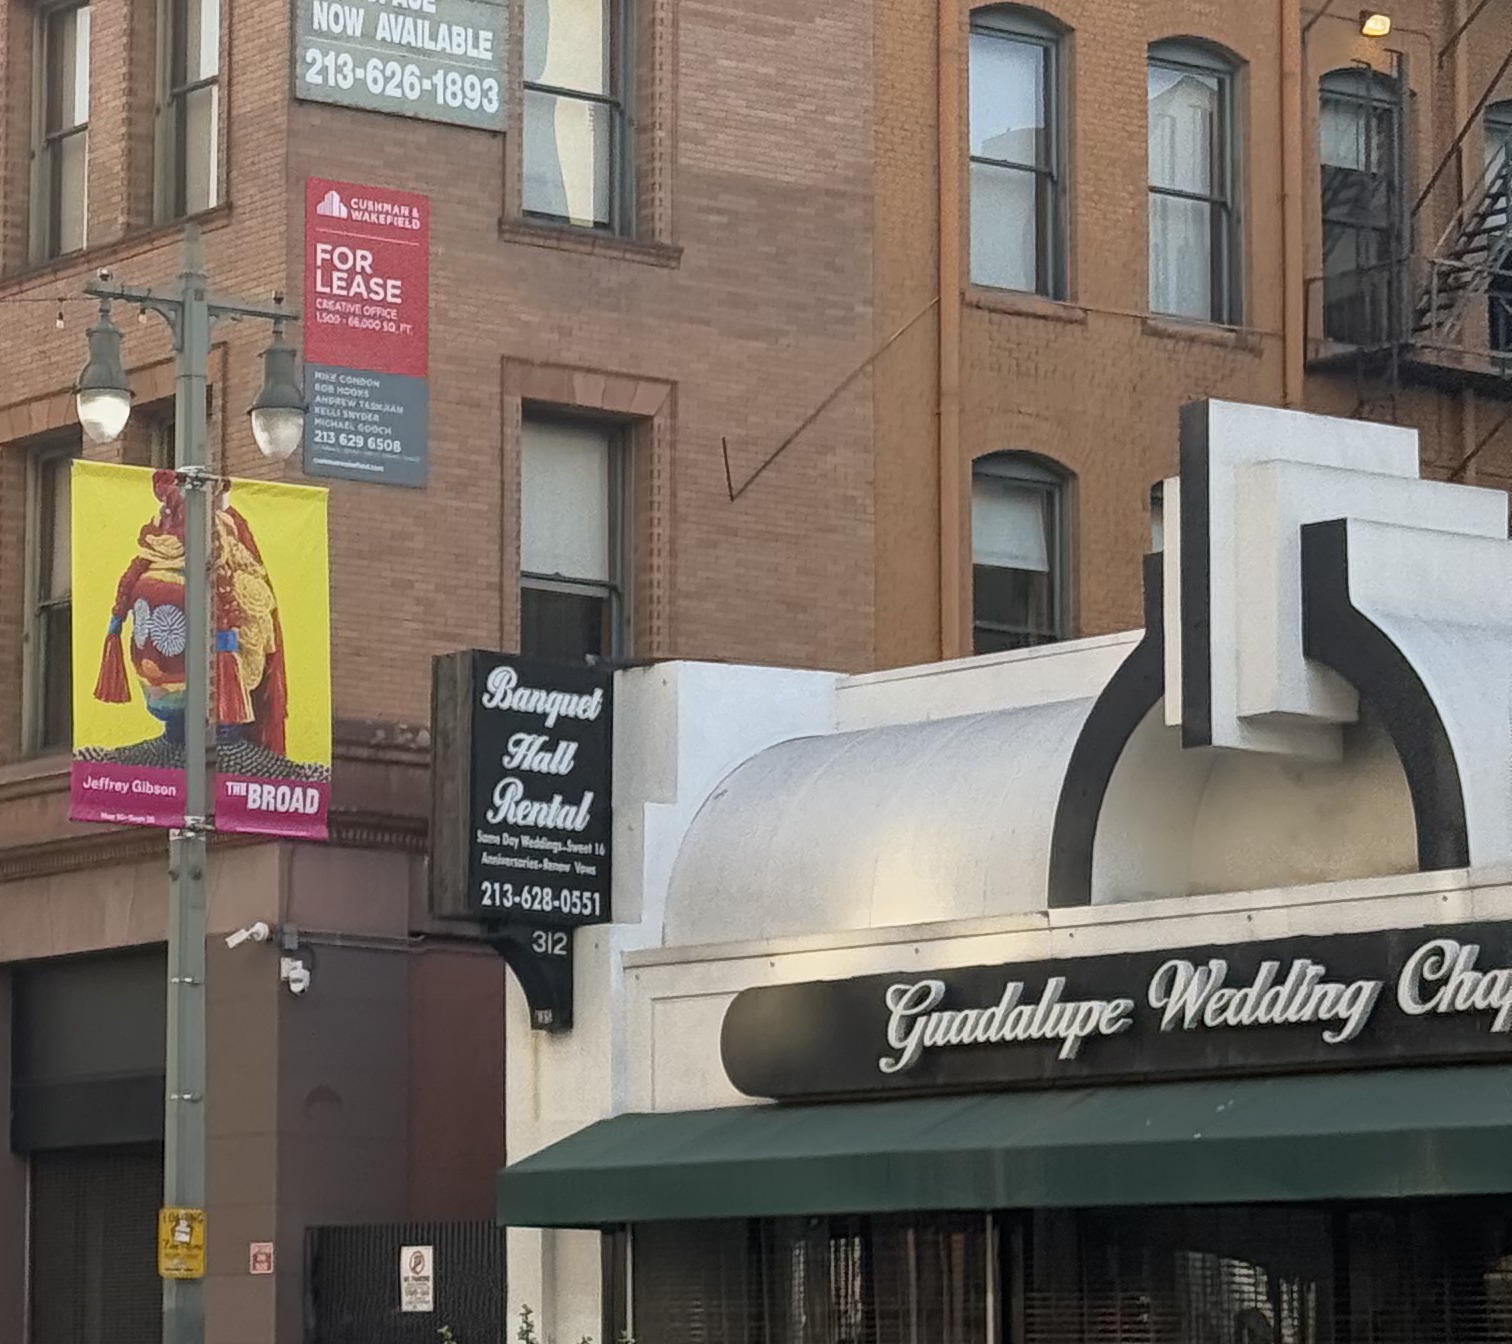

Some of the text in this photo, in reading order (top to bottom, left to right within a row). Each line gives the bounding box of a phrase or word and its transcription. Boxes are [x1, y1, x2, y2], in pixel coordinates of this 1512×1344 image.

[312, 0, 494, 61] NOW AVAILABLE
[305, 48, 500, 114] 213-626-1893
[350, 198, 420, 218] CUSHMAN &
[350, 209, 421, 231] WAKEFIELD
[315, 243, 374, 275] FOR
[315, 268, 403, 304] LEASE
[315, 297, 398, 320] CREATIVE OFFICE
[338, 374, 381, 388] CONDON
[314, 394, 357, 408] ANDREW
[314, 417, 356, 432] MICHAEL
[342, 410, 380, 423] SNYDER
[313, 430, 336, 444] 213
[338, 433, 365, 448] 629
[481, 665, 604, 729] Banquet
[501, 731, 579, 776] Hall
[82, 776, 177, 798] Jeffrey Gibson
[225, 781, 320, 815] THE BROAD
[485, 776, 595, 833] Rental
[502, 832, 520, 851] Day
[594, 842, 606, 857] 16
[480, 880, 600, 917] 213-628-0551
[531, 930, 568, 956] 312
[879, 976, 1135, 1074] Guadalupe
[1148, 957, 1383, 1045] Wedding
